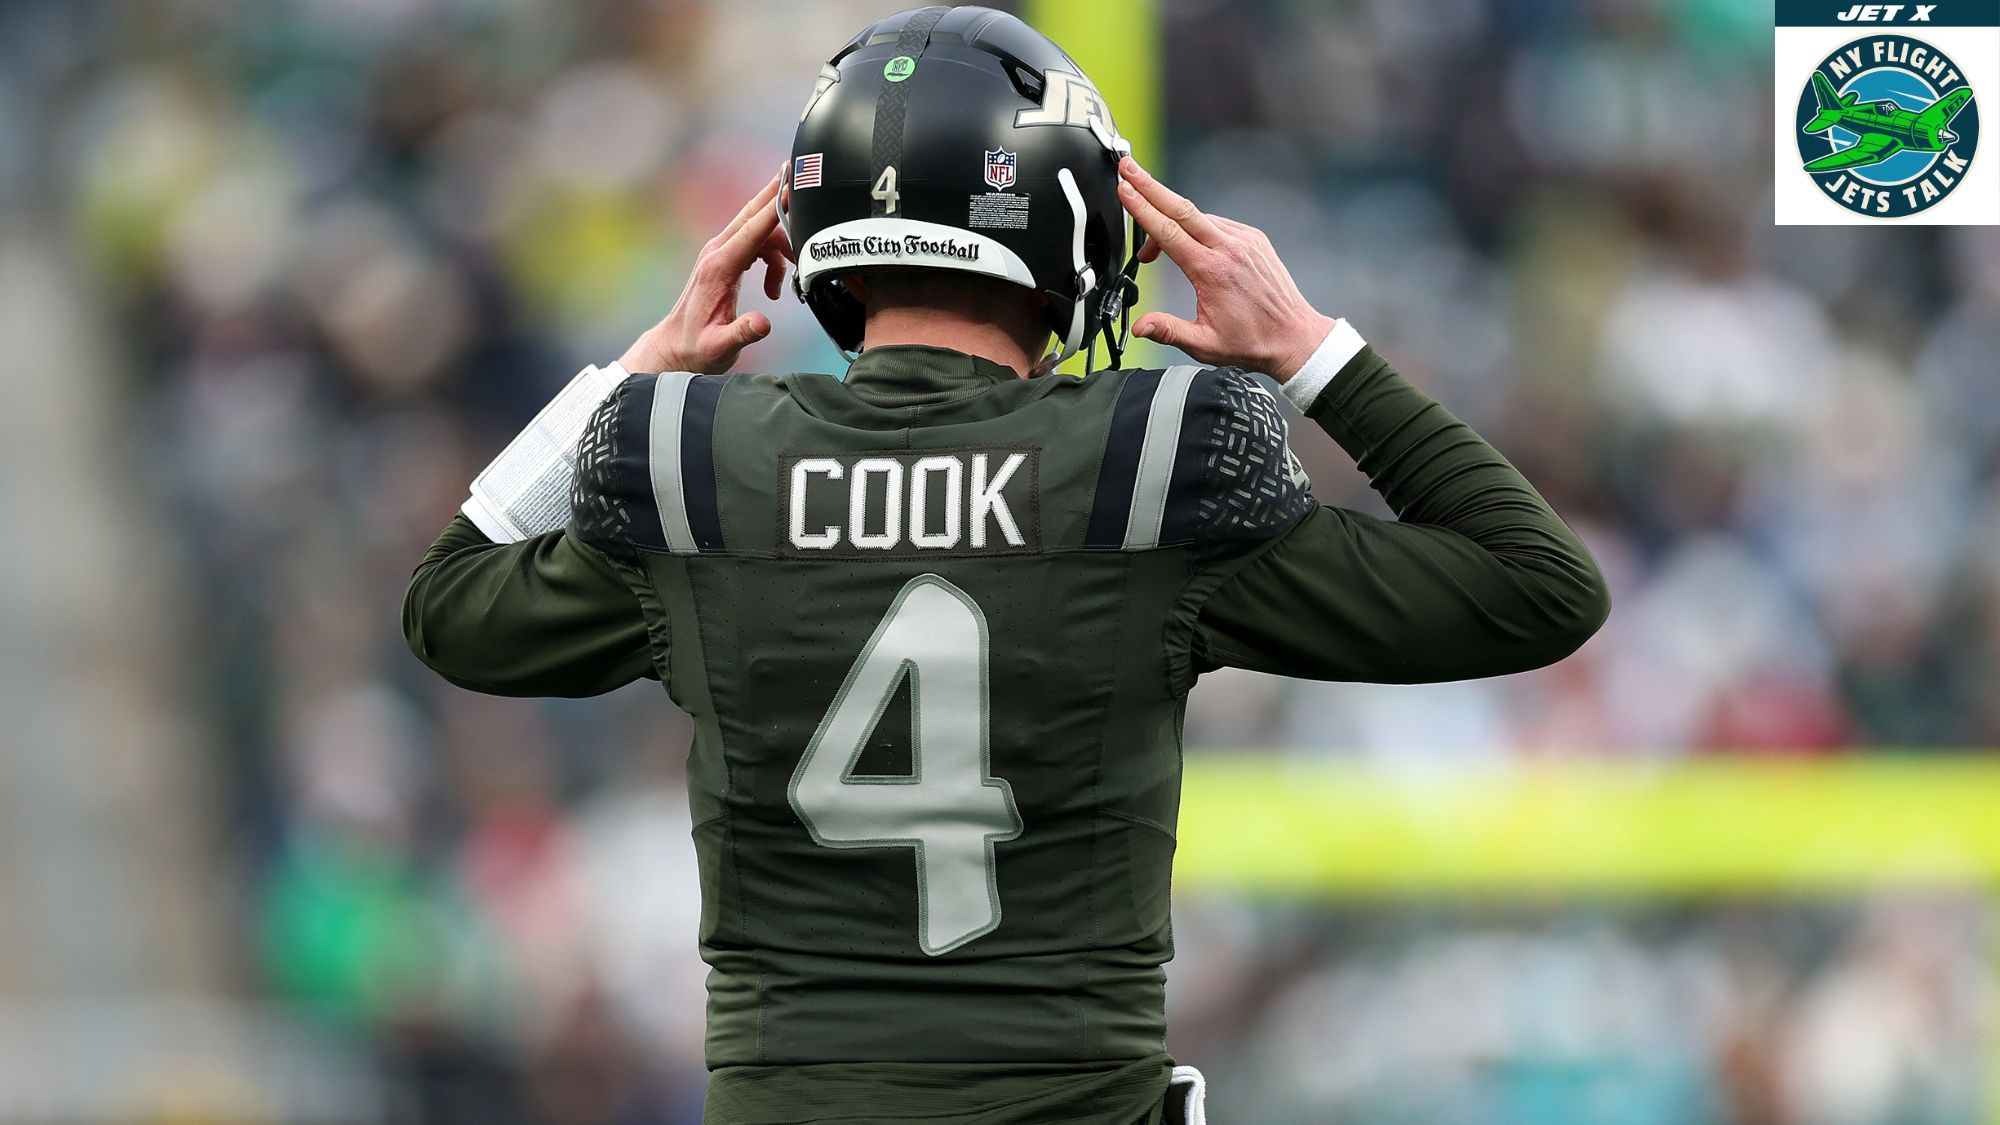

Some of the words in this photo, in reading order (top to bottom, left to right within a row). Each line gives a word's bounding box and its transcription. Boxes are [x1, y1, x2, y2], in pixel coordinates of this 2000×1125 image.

[871, 165, 900, 214] 4
[989, 165, 1012, 183] NFL
[809, 236, 862, 262] Gotham
[863, 235, 901, 257] City
[904, 234, 980, 261] Football
[789, 453, 1029, 550] COOK
[787, 573, 1024, 956] 4
